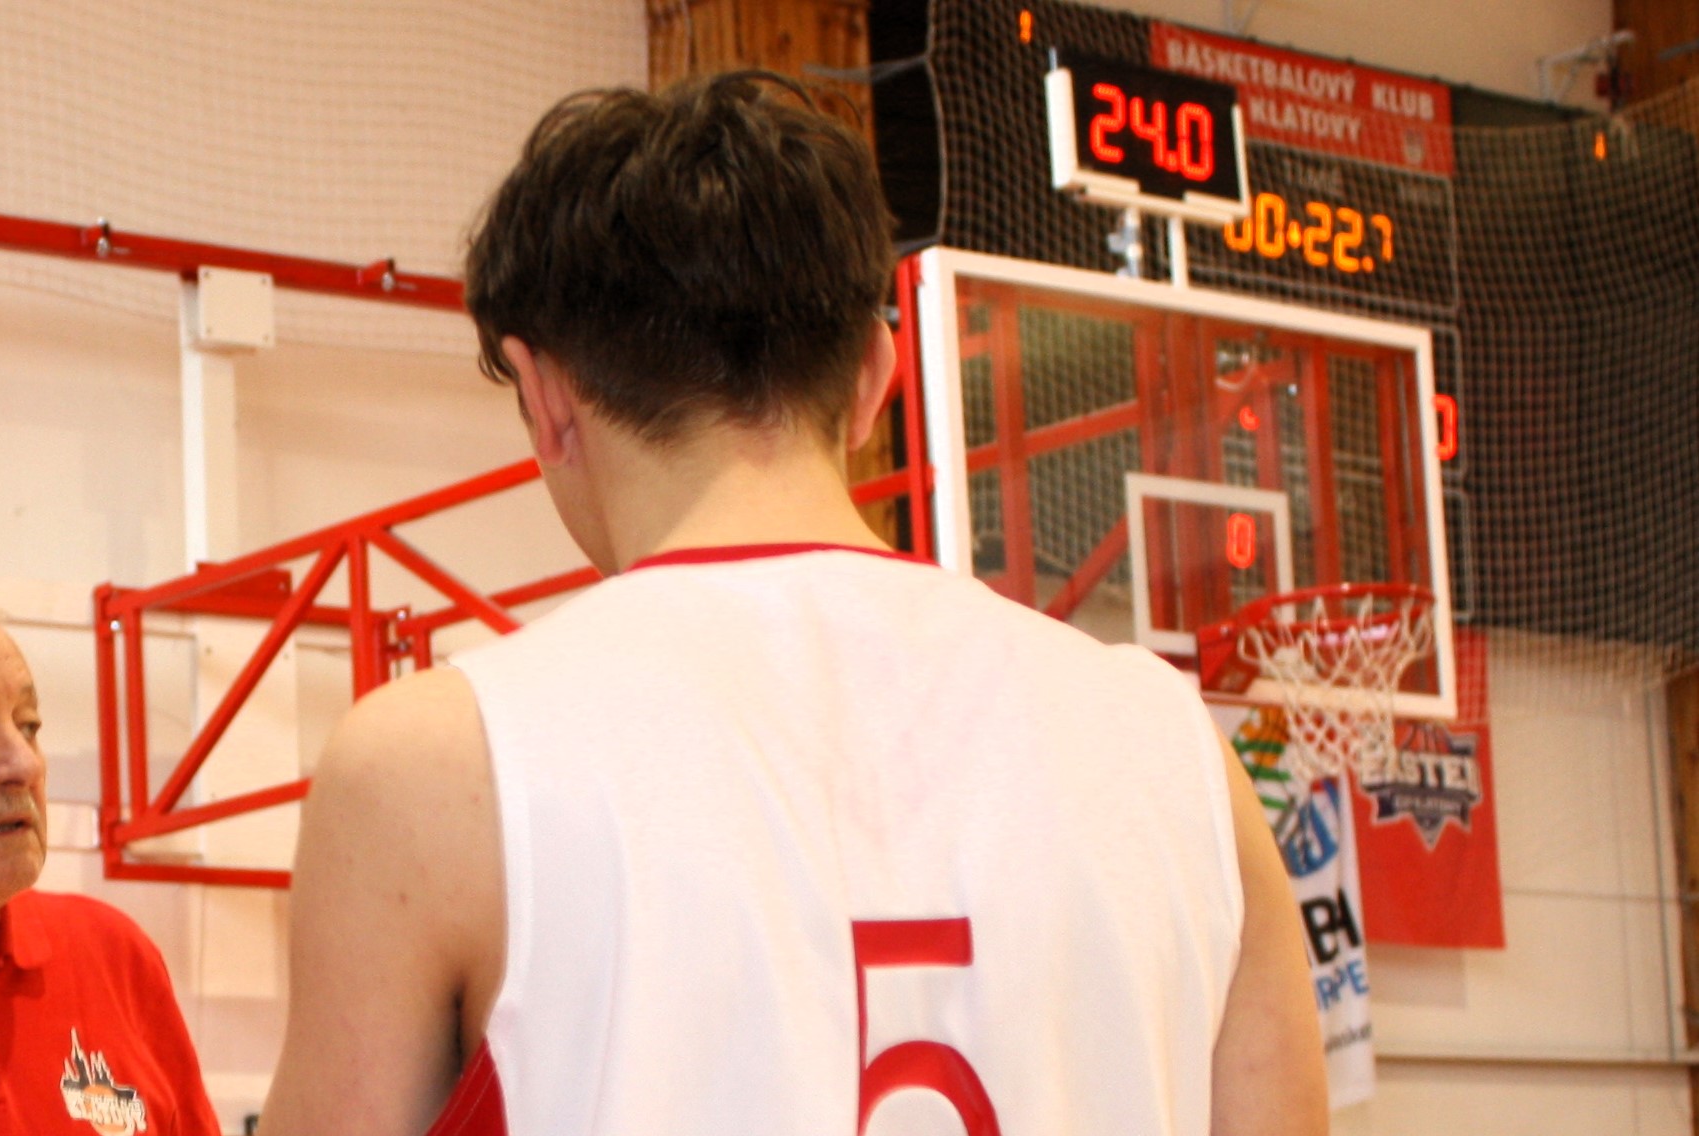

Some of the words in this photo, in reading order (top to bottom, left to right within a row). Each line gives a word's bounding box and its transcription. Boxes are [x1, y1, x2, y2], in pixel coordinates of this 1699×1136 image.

[1249, 95, 1362, 143] KLATOVY
[1371, 82, 1436, 122] KLUB
[1089, 82, 1215, 182] 24.0
